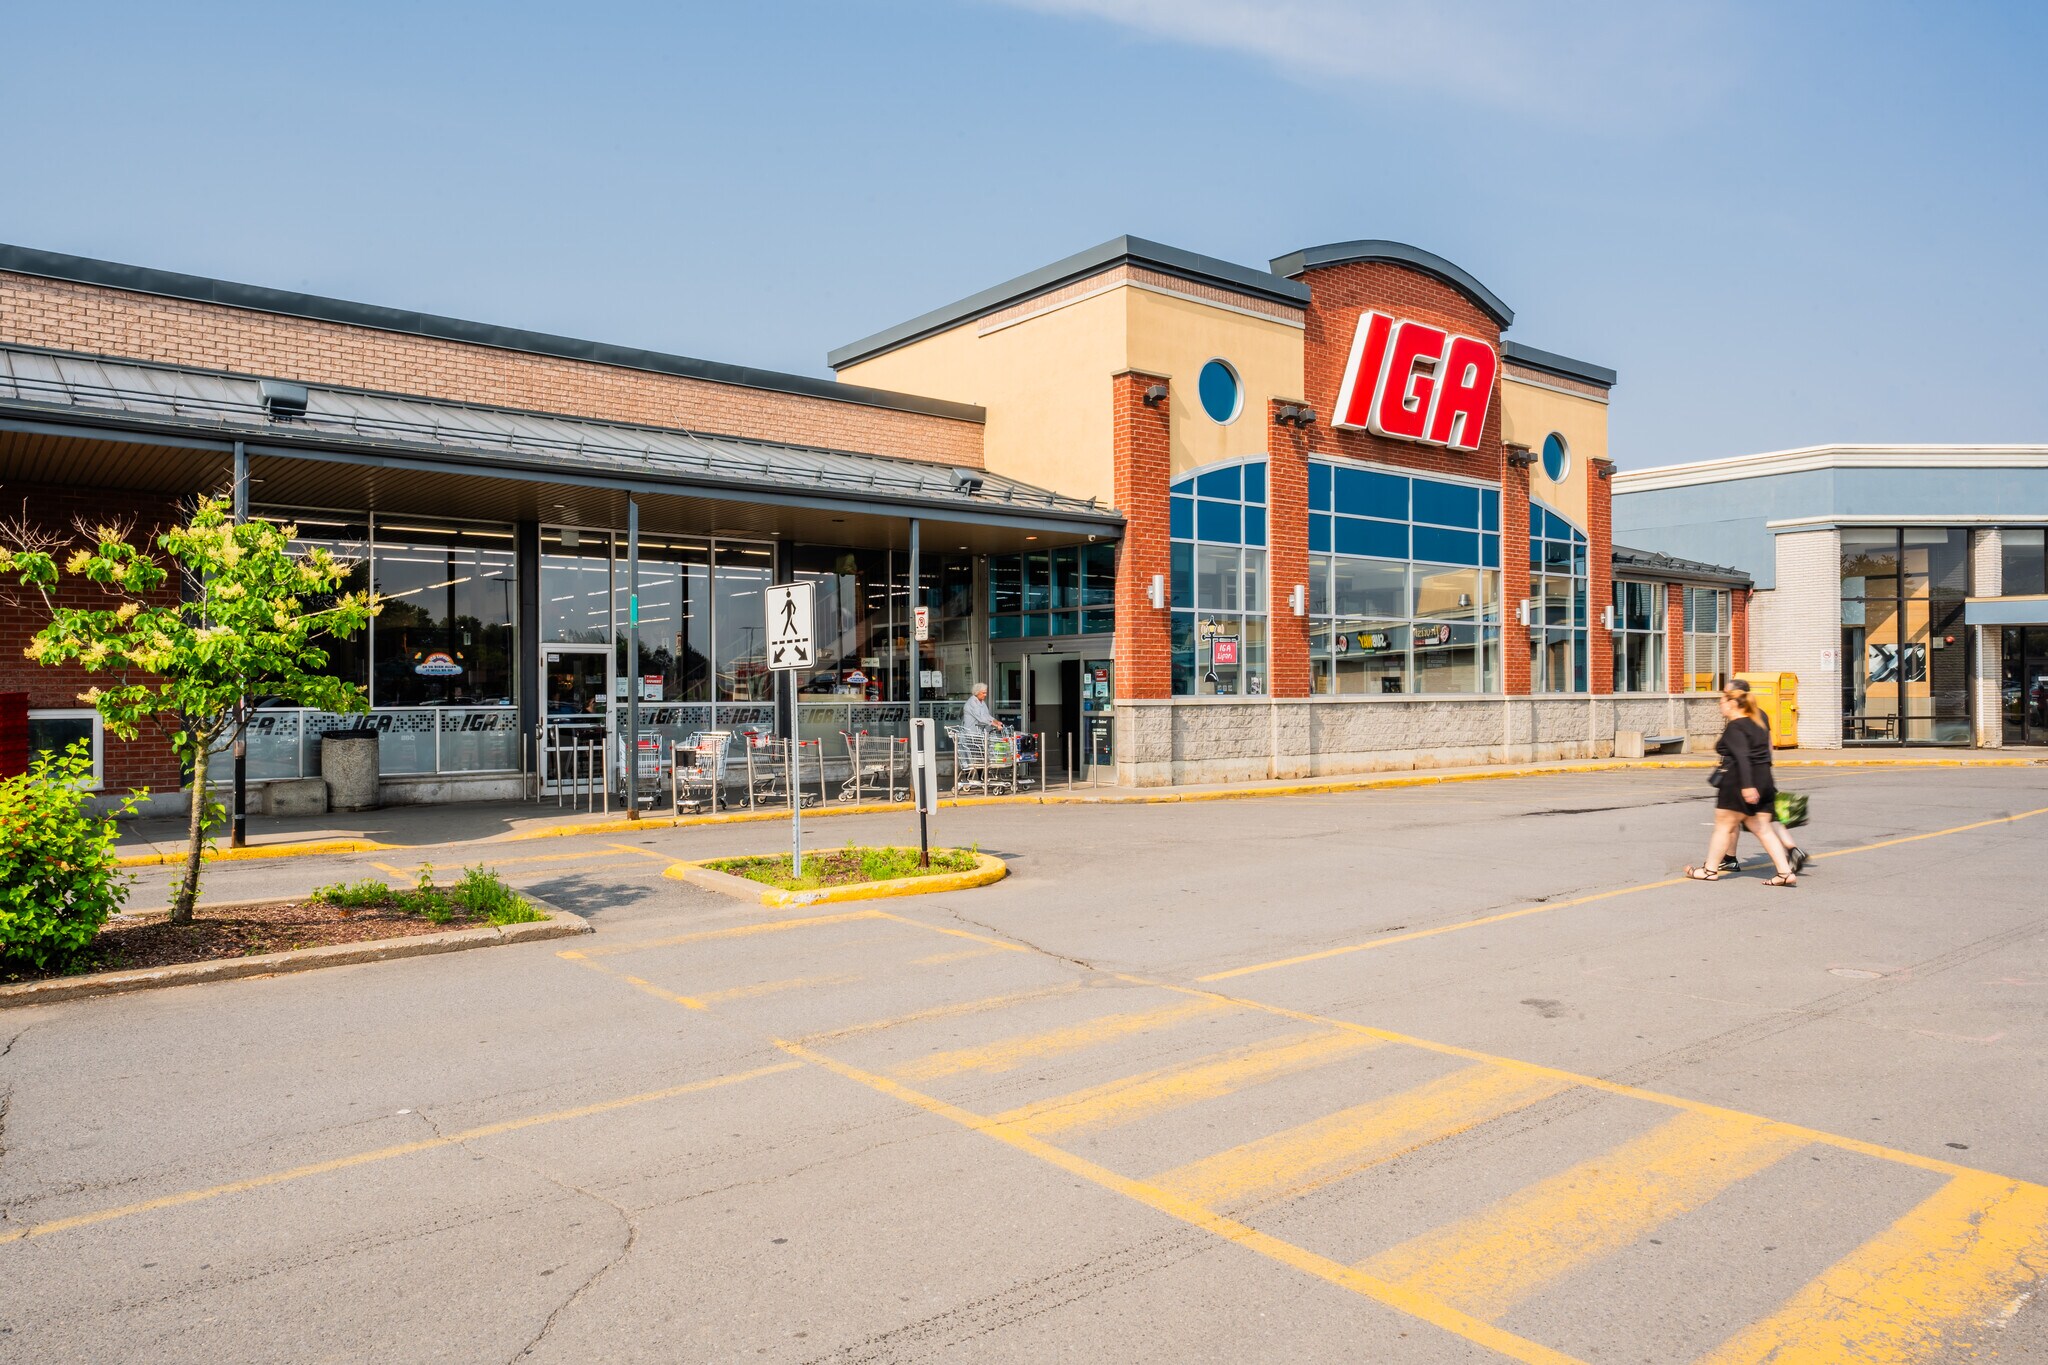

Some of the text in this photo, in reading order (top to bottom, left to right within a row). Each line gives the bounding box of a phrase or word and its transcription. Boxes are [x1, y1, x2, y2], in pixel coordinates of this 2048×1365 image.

[1332, 310, 1497, 452] IGA
[1219, 644, 1232, 652] IGA
[731, 708, 761, 724] IGA
[807, 708, 834, 723] IGA
[879, 707, 903, 722] IGA
[352, 714, 393, 733] IGA
[460, 714, 499, 732] IGA
